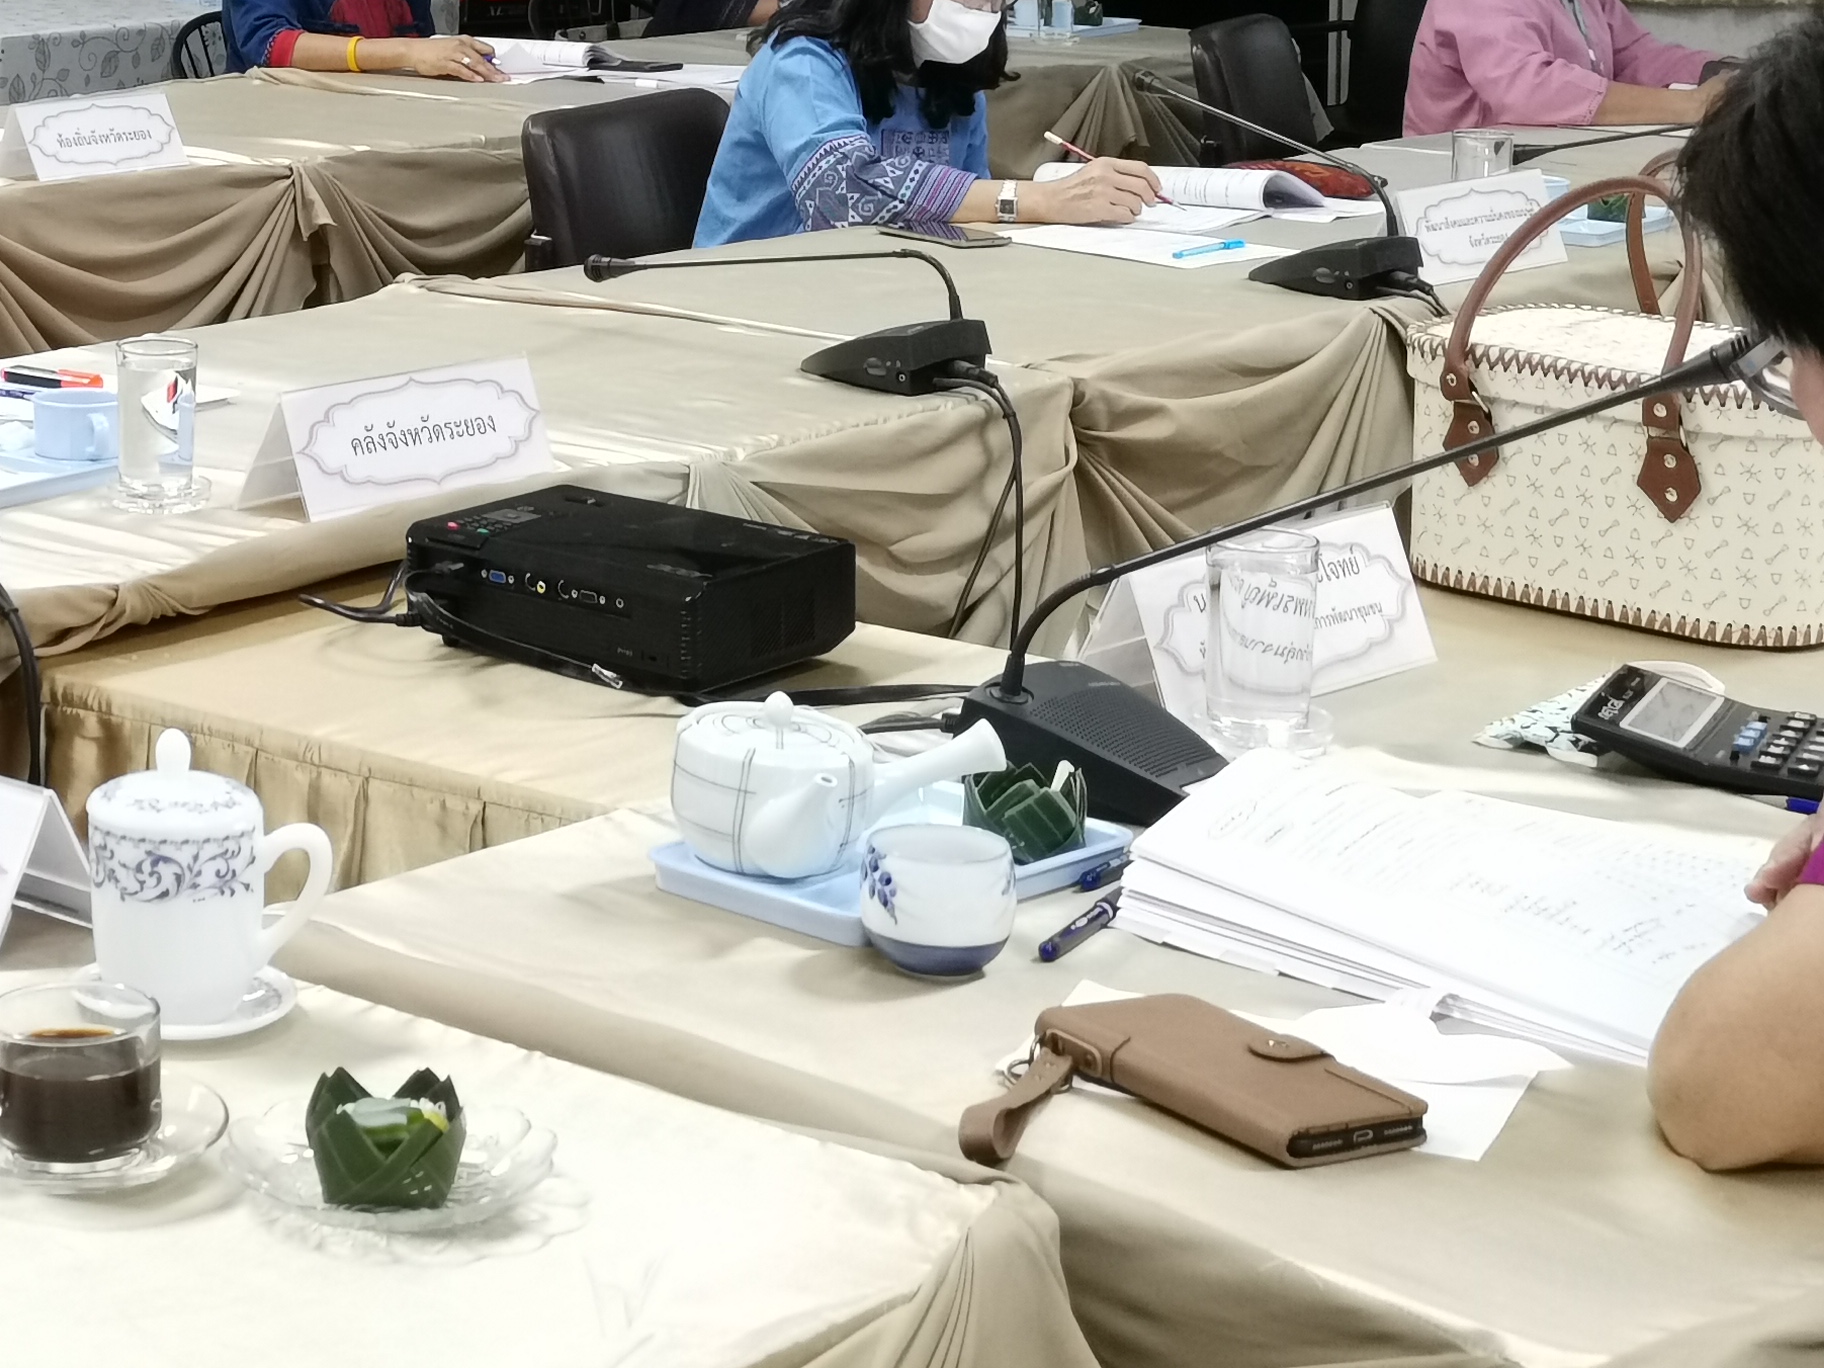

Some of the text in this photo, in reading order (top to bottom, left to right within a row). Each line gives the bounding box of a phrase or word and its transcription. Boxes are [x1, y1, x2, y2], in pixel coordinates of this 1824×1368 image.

[56, 127, 153, 149] ท้องถิ่นจังหวัดระยอง
[350, 413, 497, 457] คลังจังหวัดระยอง
[1314, 606, 1383, 630] การพัฒนาชุมชน
